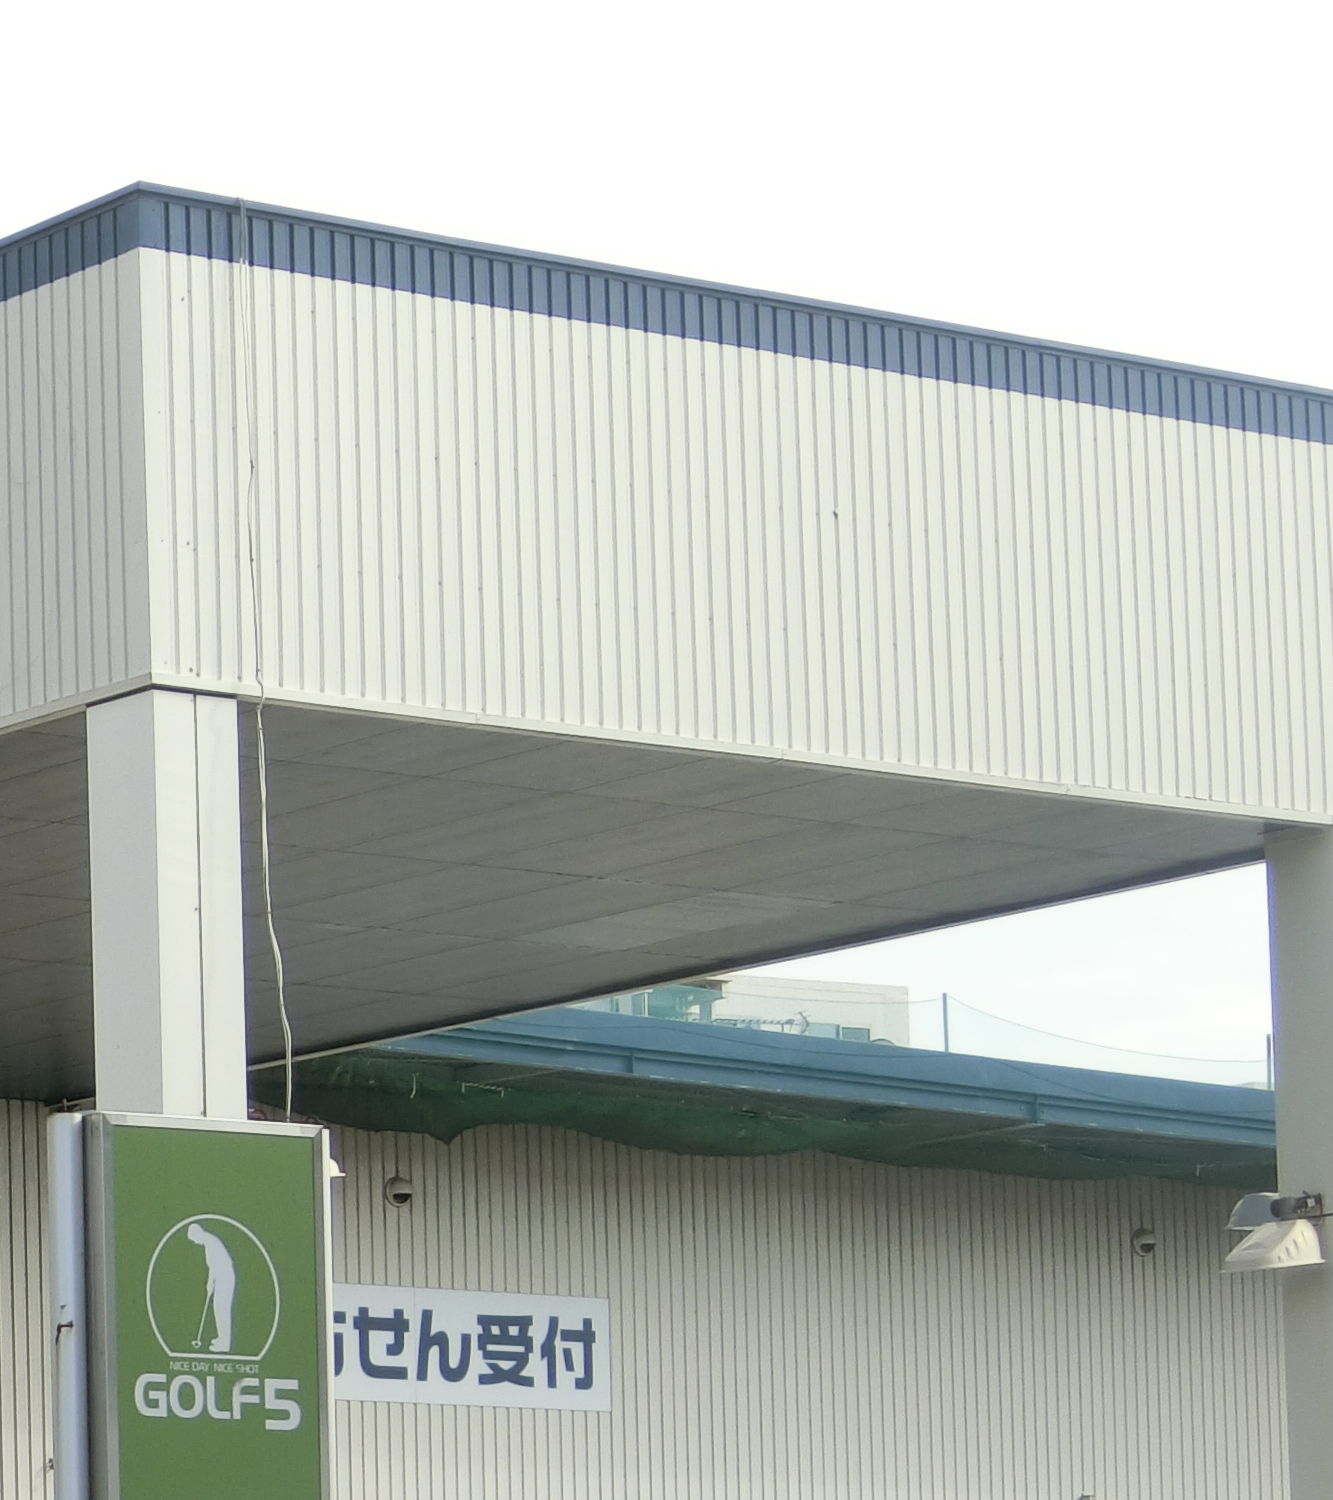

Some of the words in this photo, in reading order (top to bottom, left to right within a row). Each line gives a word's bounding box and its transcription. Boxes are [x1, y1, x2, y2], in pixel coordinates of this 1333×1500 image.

[333, 1306, 596, 1391] せん受付
[134, 1373, 301, 1431] GOLF5
